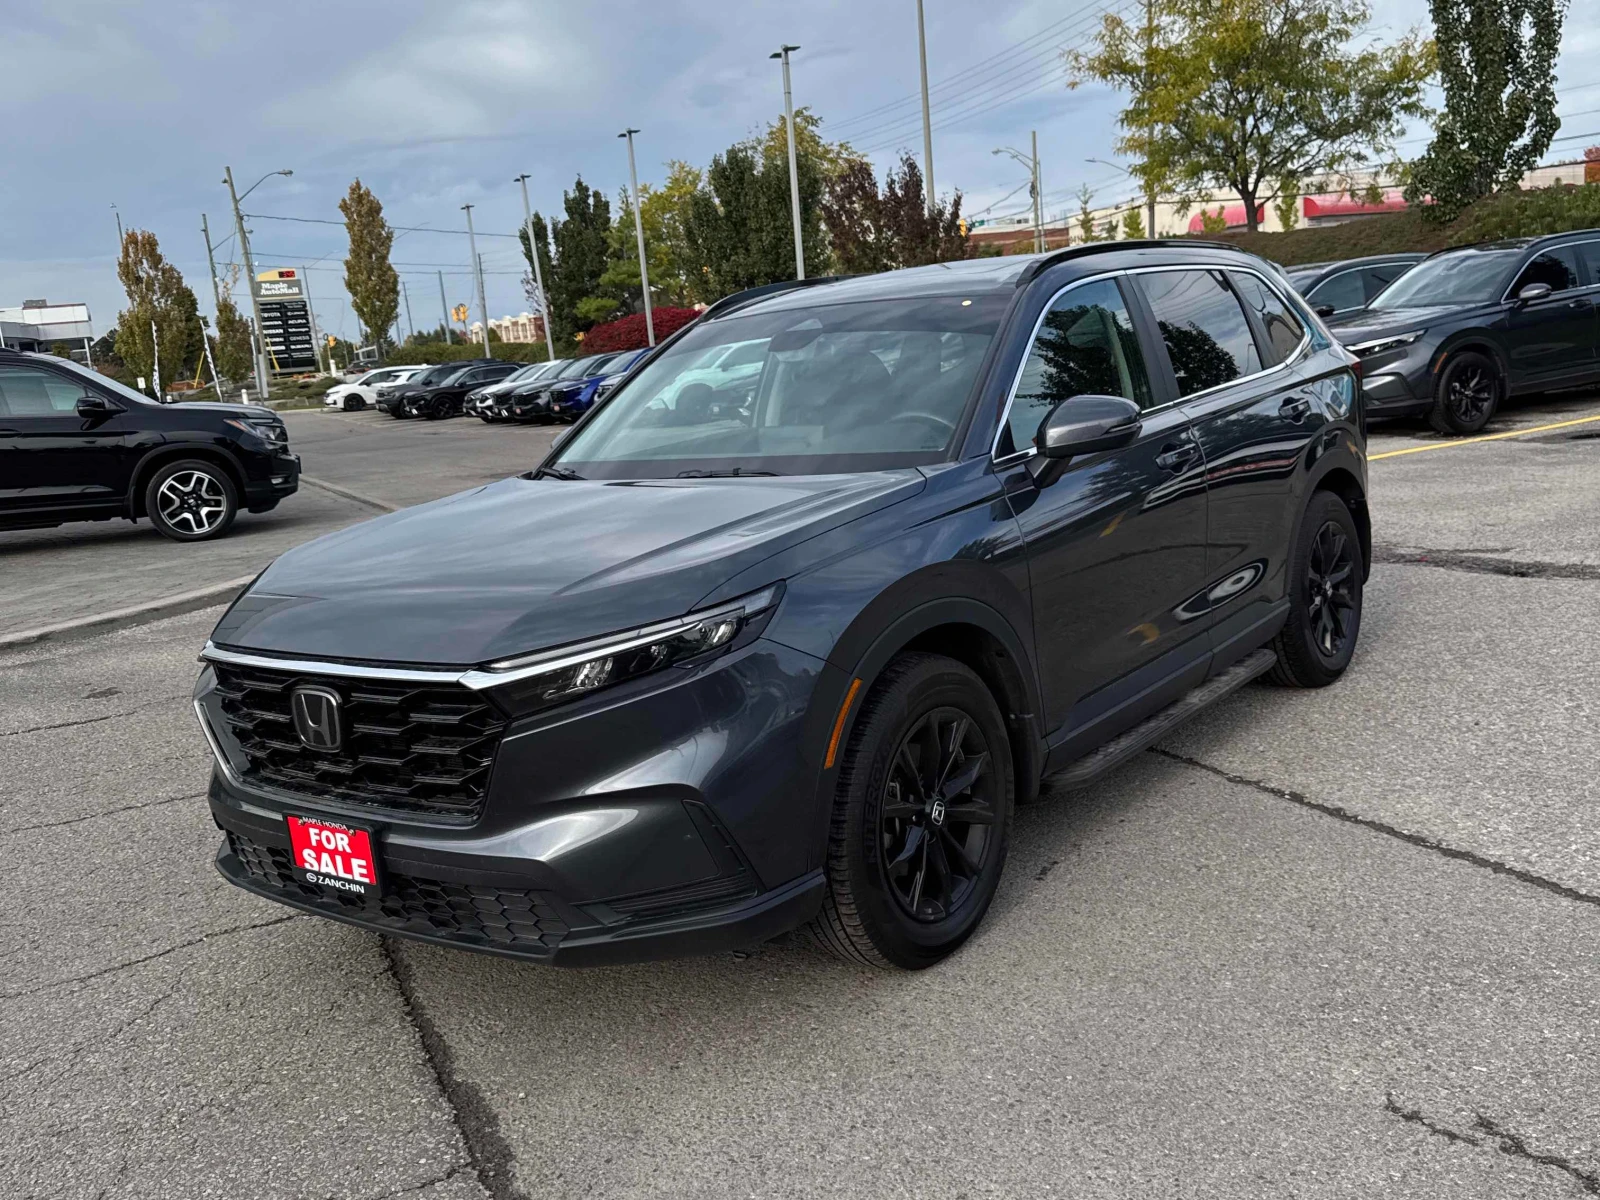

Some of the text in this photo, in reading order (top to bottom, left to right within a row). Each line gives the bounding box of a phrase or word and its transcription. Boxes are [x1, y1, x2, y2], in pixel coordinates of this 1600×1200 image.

[260, 287, 300, 295] AutoMall
[261, 282, 288, 290] Maple
[302, 816, 348, 831] MAPLE HONDA
[308, 827, 353, 854] FOR
[302, 848, 370, 883] SALE
[317, 875, 365, 894] ZANCHIN
